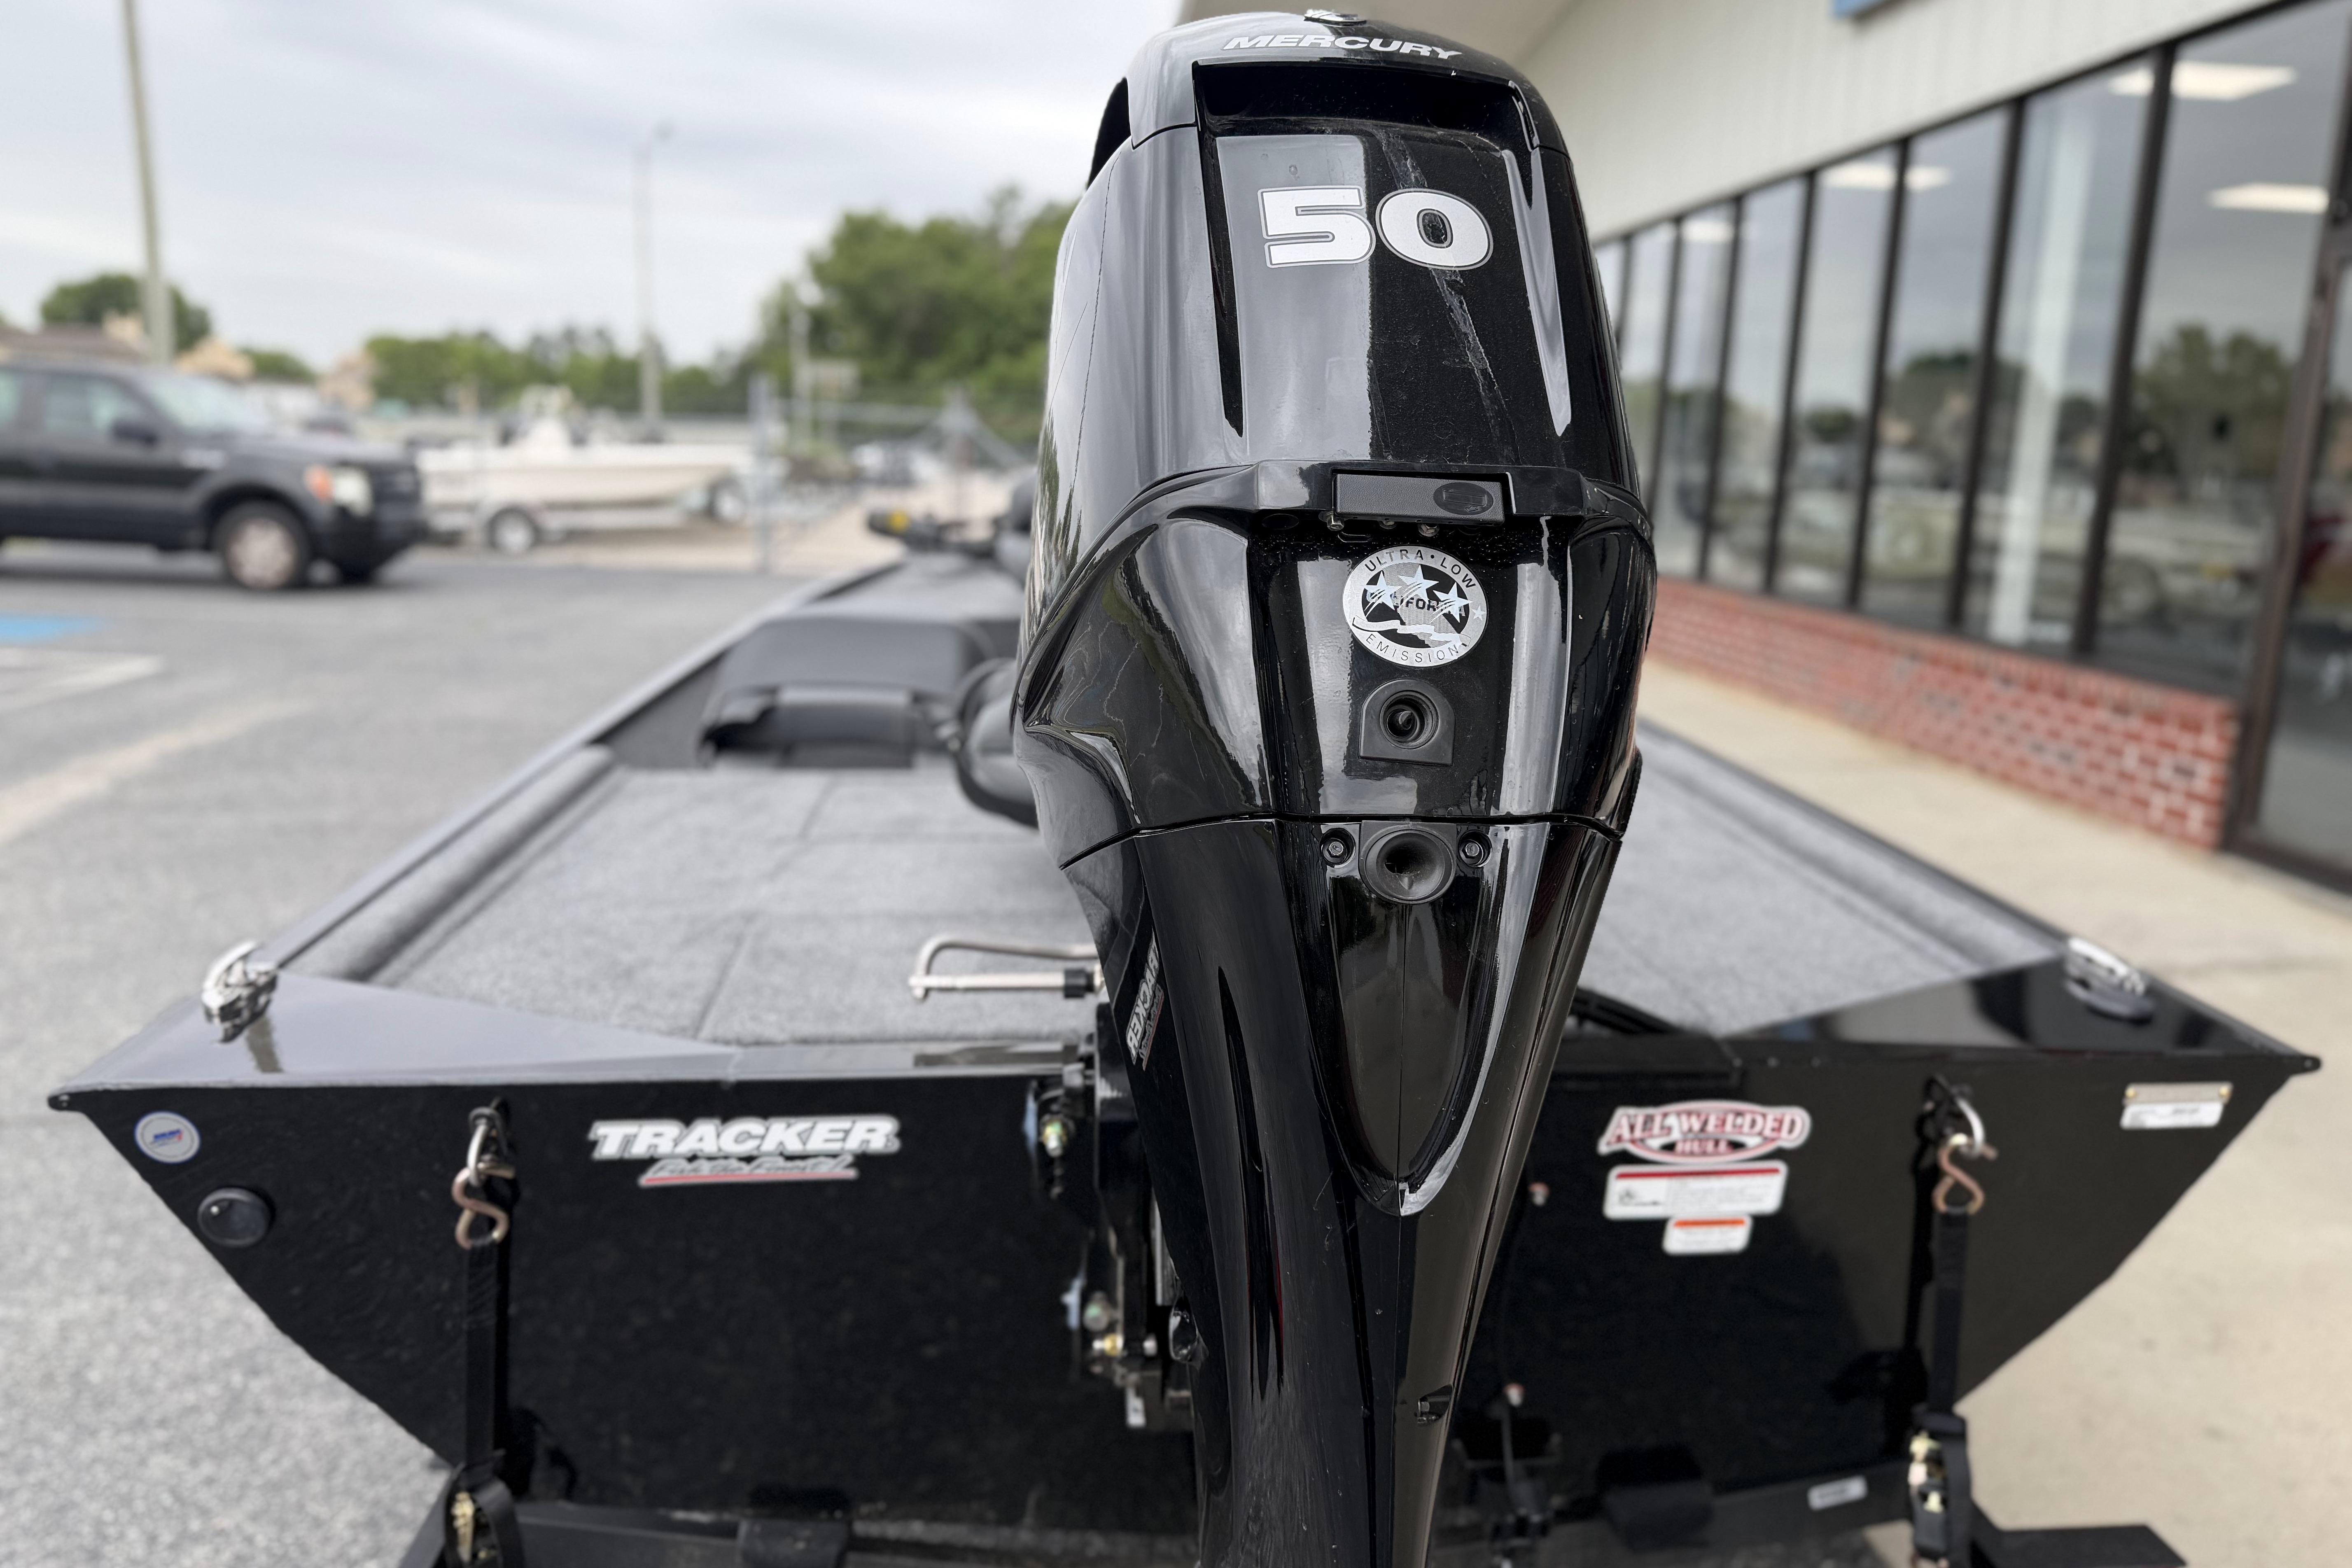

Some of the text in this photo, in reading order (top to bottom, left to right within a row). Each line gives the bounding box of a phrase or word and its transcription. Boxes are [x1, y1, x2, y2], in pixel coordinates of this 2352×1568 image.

[1223, 34, 1462, 60] MERCURY
[1257, 185, 1493, 271] 50
[1440, 557, 1476, 588] LOW
[1366, 633, 1459, 663] EMISSION
[592, 1118, 898, 1156] TRACKER
[1607, 1112, 1803, 1145] ALL WELDED
[1673, 1140, 1734, 1153] HULL
